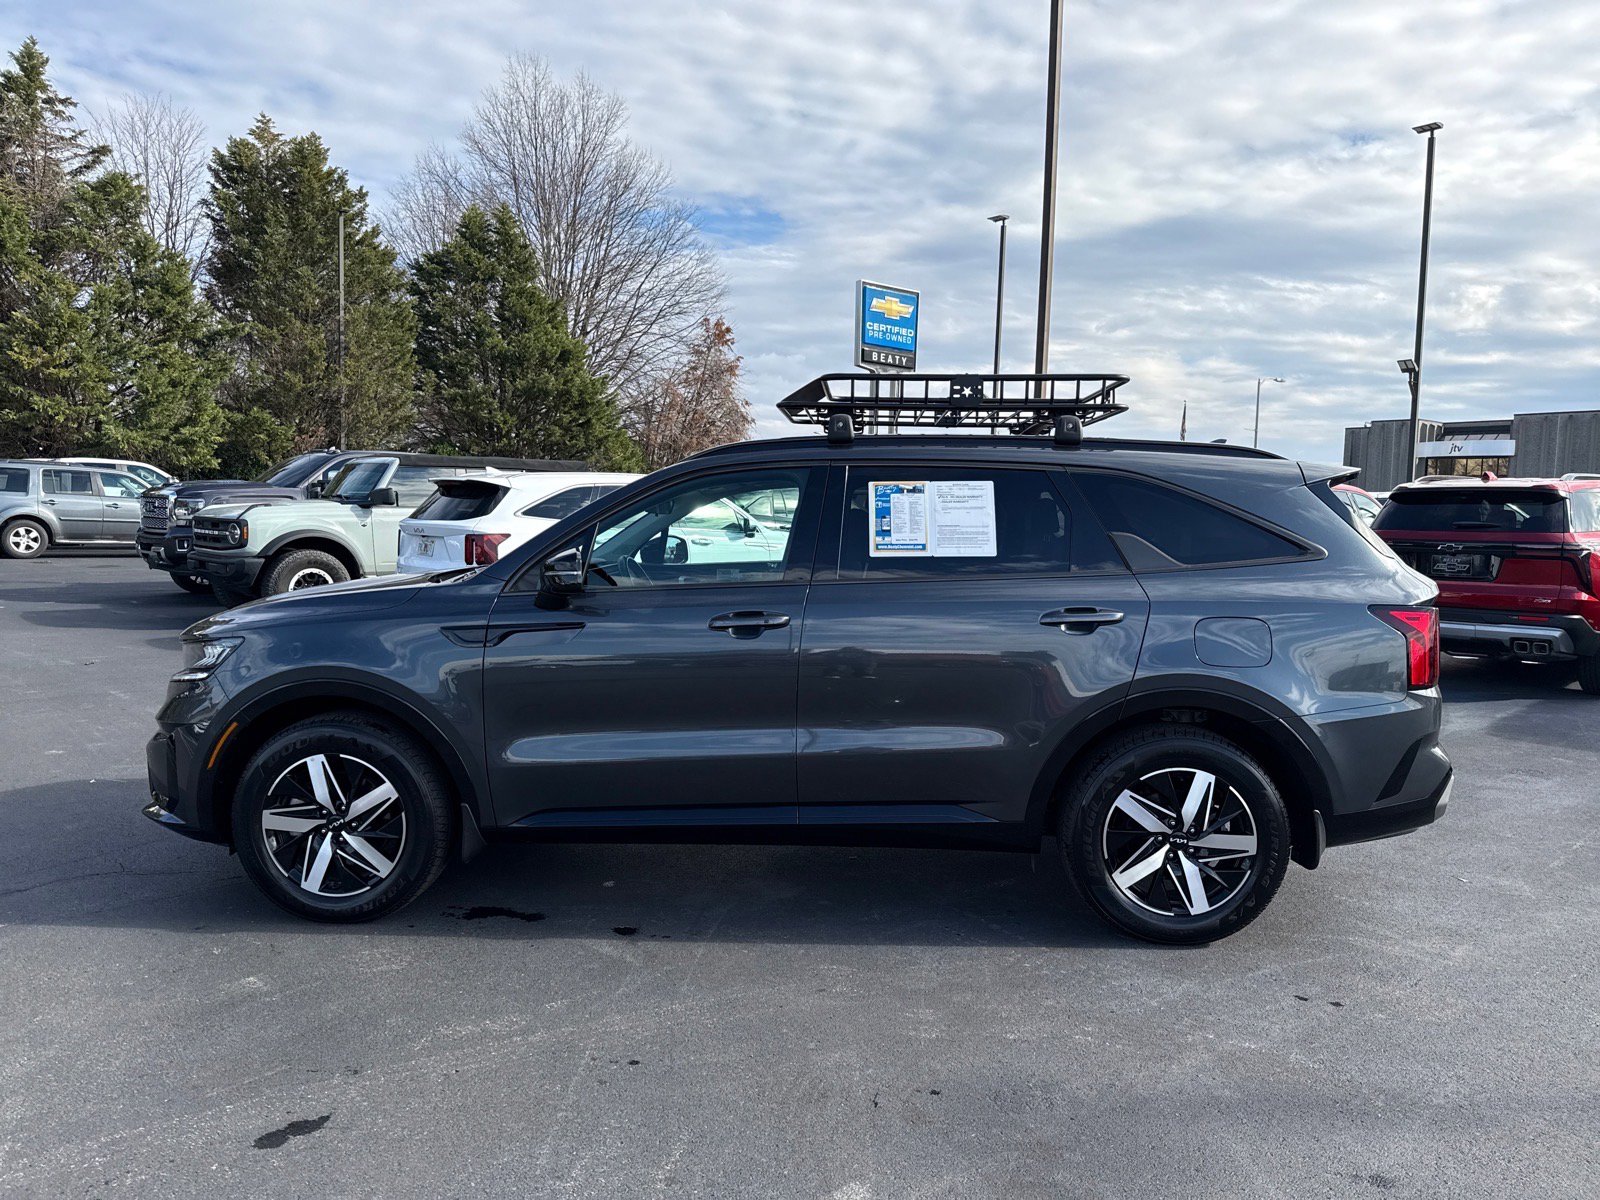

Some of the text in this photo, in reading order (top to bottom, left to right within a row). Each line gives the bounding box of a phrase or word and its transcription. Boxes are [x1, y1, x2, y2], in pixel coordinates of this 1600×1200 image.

[866, 322, 914, 337] CERTIFIED
[868, 330, 912, 344] PRE-OWNED
[872, 352, 907, 366] BEATY
[1449, 443, 1464, 454] jtv
